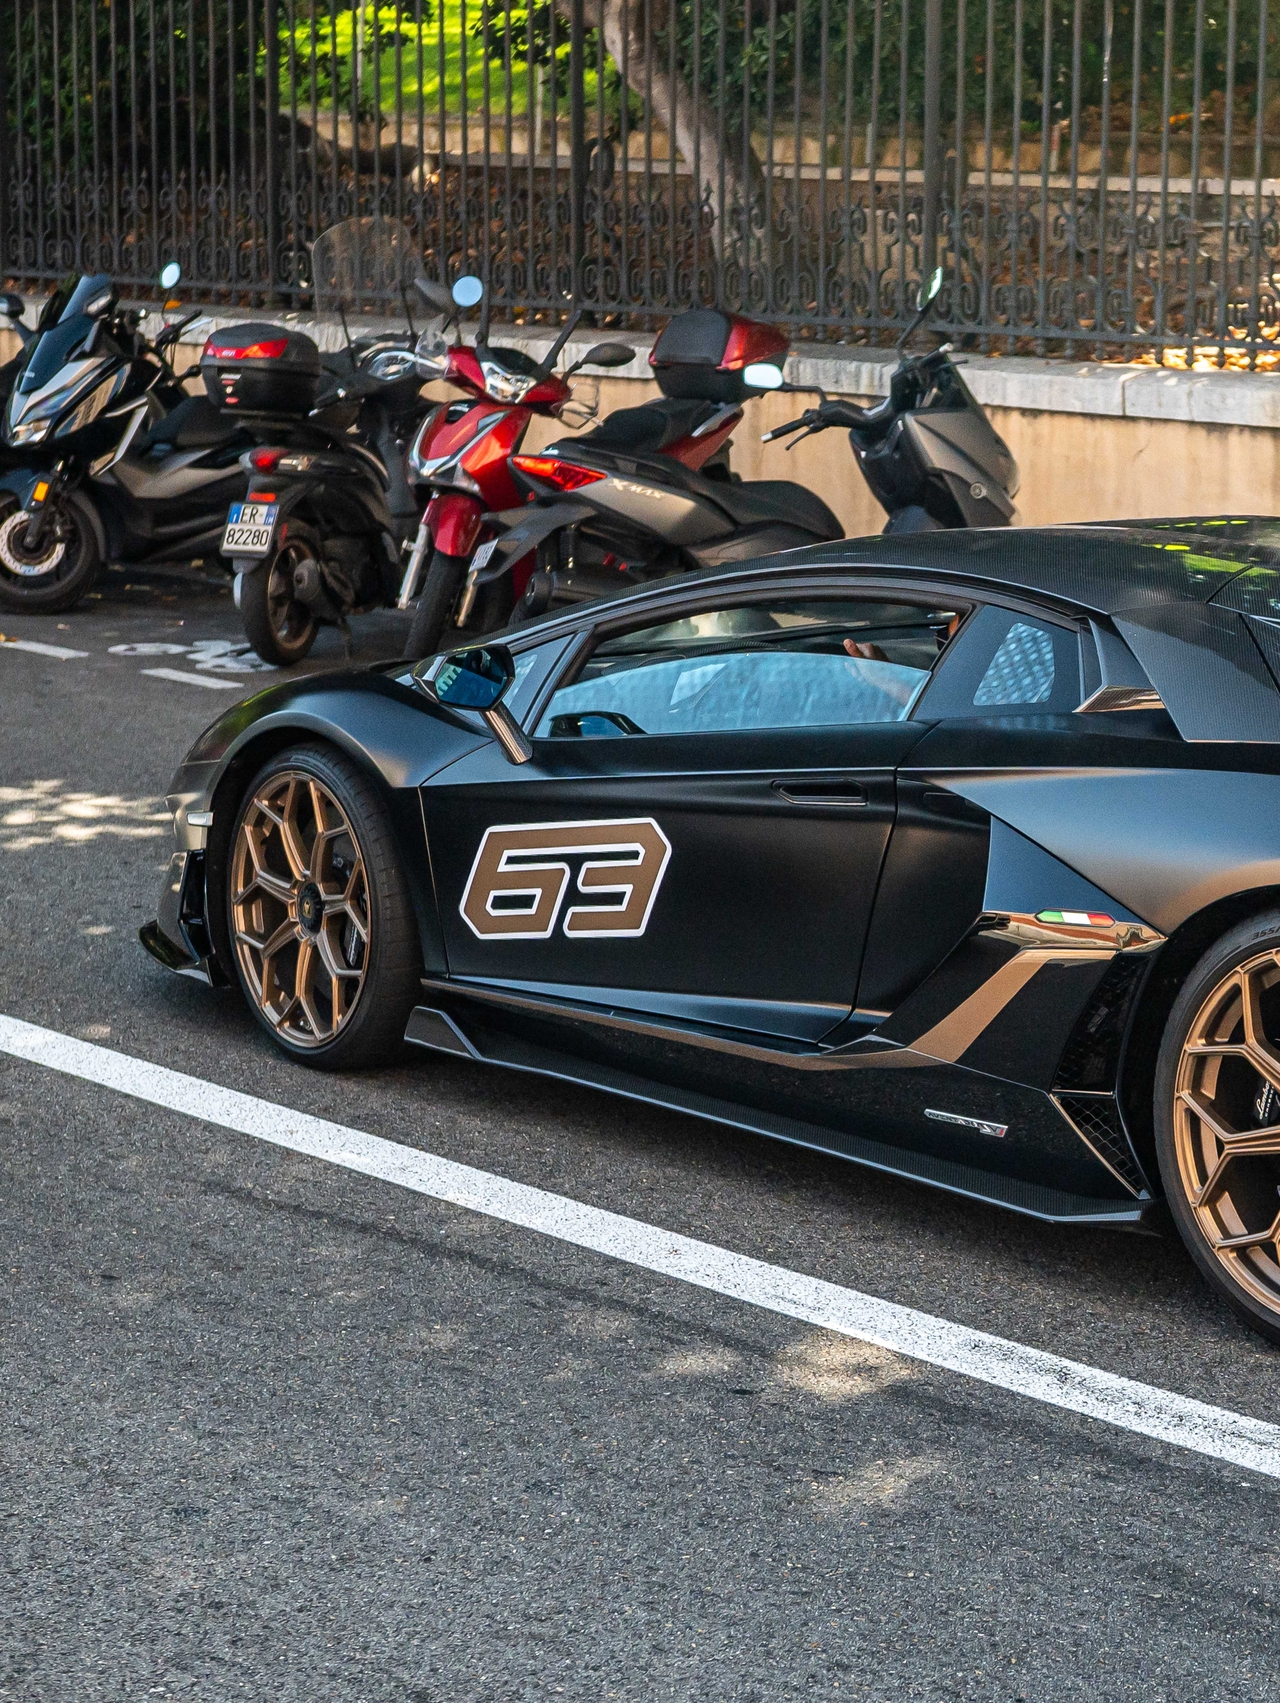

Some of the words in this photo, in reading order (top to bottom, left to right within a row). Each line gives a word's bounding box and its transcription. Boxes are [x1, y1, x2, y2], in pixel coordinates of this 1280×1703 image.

[240, 506, 259, 523] ER
[226, 528, 270, 546] 82280
[459, 817, 673, 940] 63
